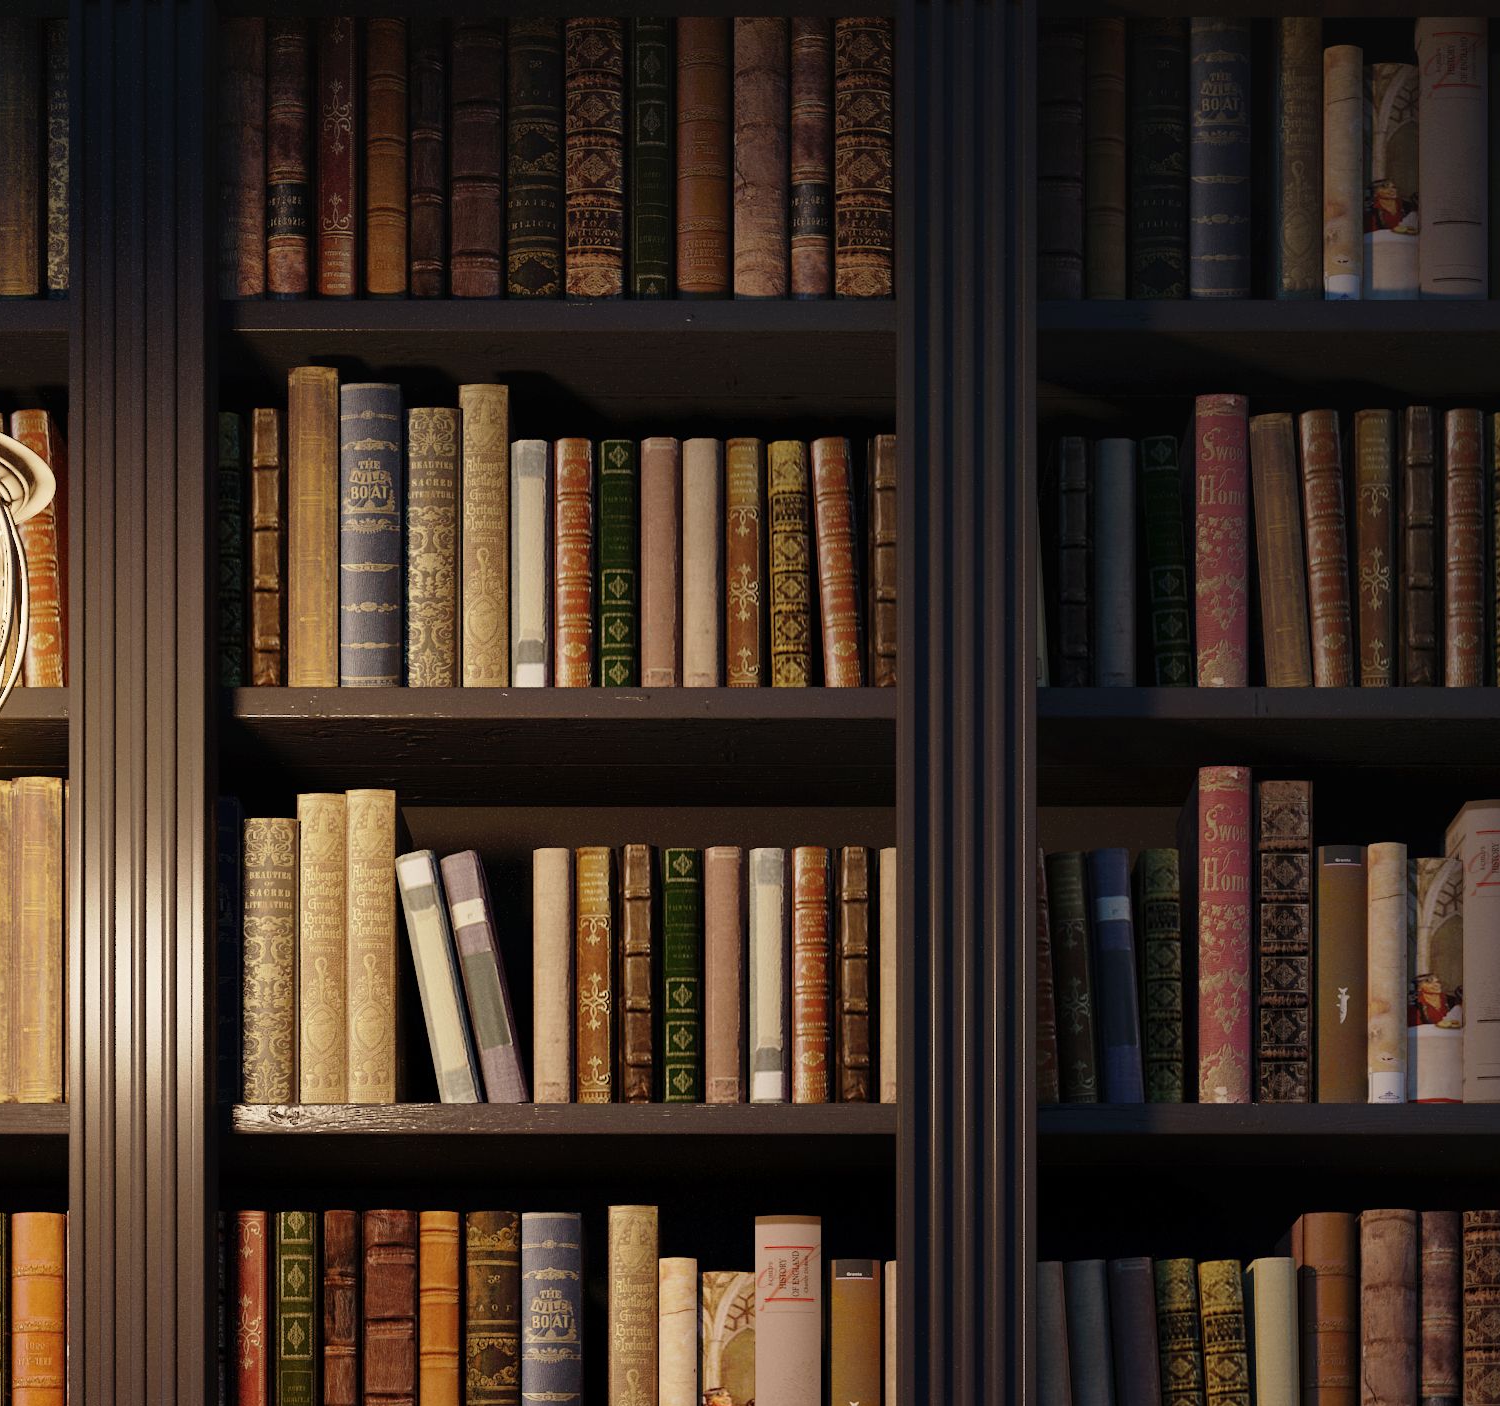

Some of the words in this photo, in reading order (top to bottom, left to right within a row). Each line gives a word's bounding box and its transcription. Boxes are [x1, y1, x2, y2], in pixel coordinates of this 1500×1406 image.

[1209, 72, 1233, 82] THE
[1201, 97, 1240, 111] BOAT
[358, 460, 381, 470] THE
[351, 470, 387, 482] NILE
[412, 479, 453, 488] SACRED
[350, 485, 388, 499] BOAT
[466, 501, 501, 515] Britain
[1204, 804, 1249, 842] Swee
[1492, 843, 1500, 874] HISTORY
[249, 871, 292, 880] BEAUTIES
[249, 889, 290, 898] SACRED
[356, 894, 383, 908] Great
[304, 911, 339, 925] Britain
[352, 907, 389, 921] Britain
[779, 1259, 787, 1290] HISTORY
[792, 1250, 800, 1286] ENGLAND
[540, 1289, 562, 1299] THE
[792, 1288, 800, 1297] OF
[533, 1299, 568, 1312] NILE
[532, 1314, 570, 1328] BOAT
